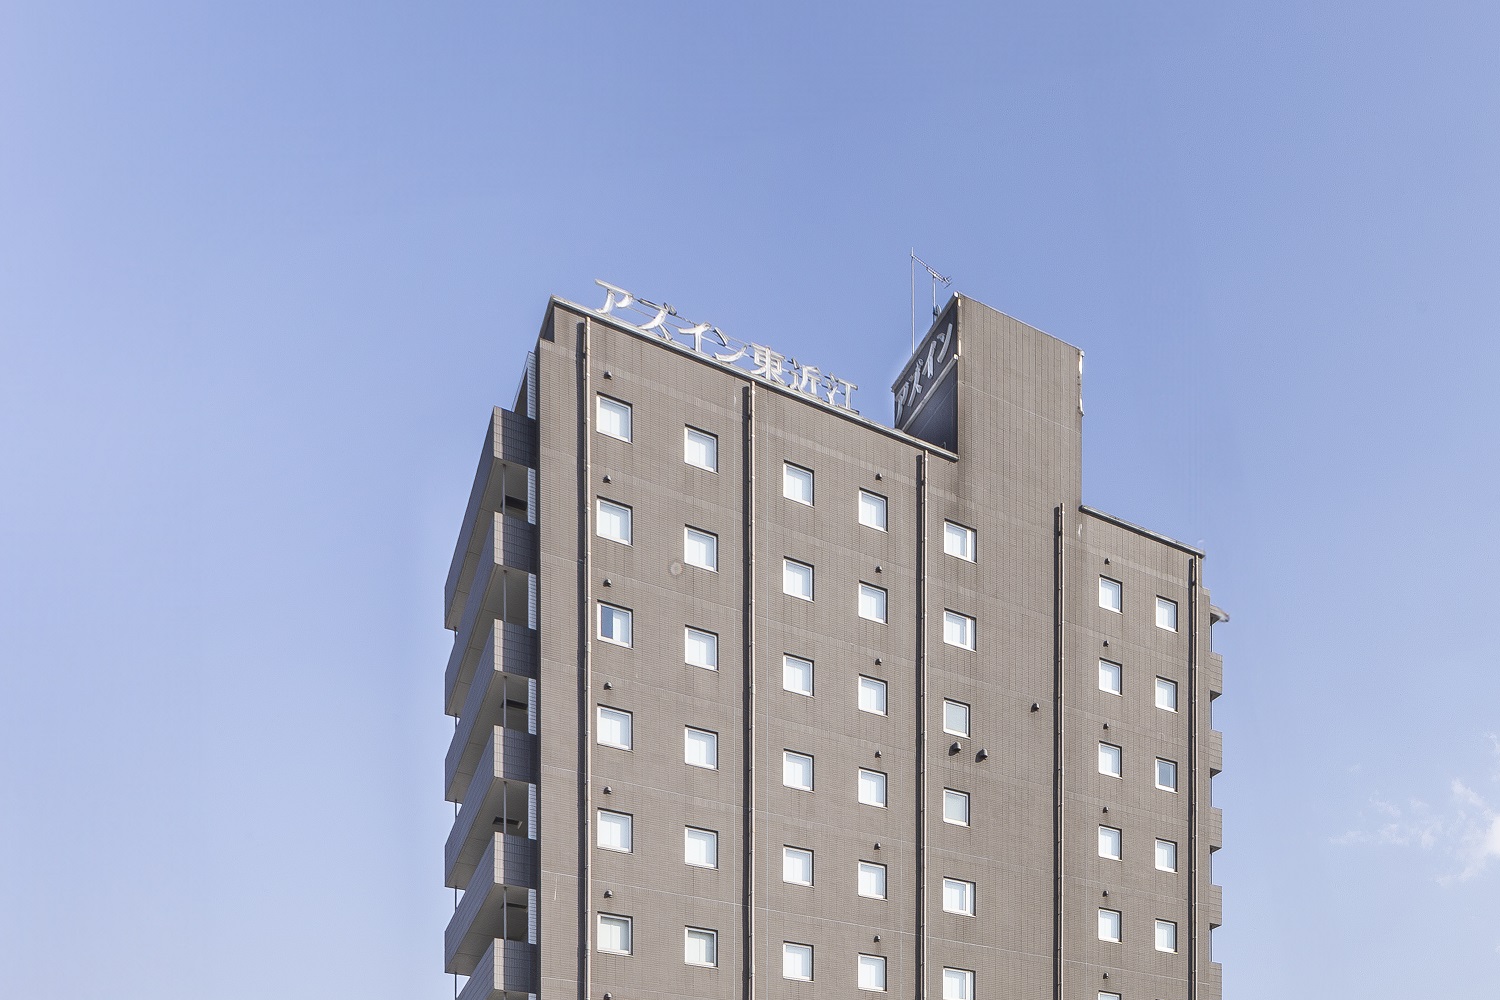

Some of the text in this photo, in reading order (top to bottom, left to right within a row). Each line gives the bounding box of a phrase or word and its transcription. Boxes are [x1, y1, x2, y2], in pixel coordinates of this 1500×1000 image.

[594, 278, 859, 413] アズイン東近江
[895, 322, 954, 424] アズイン
